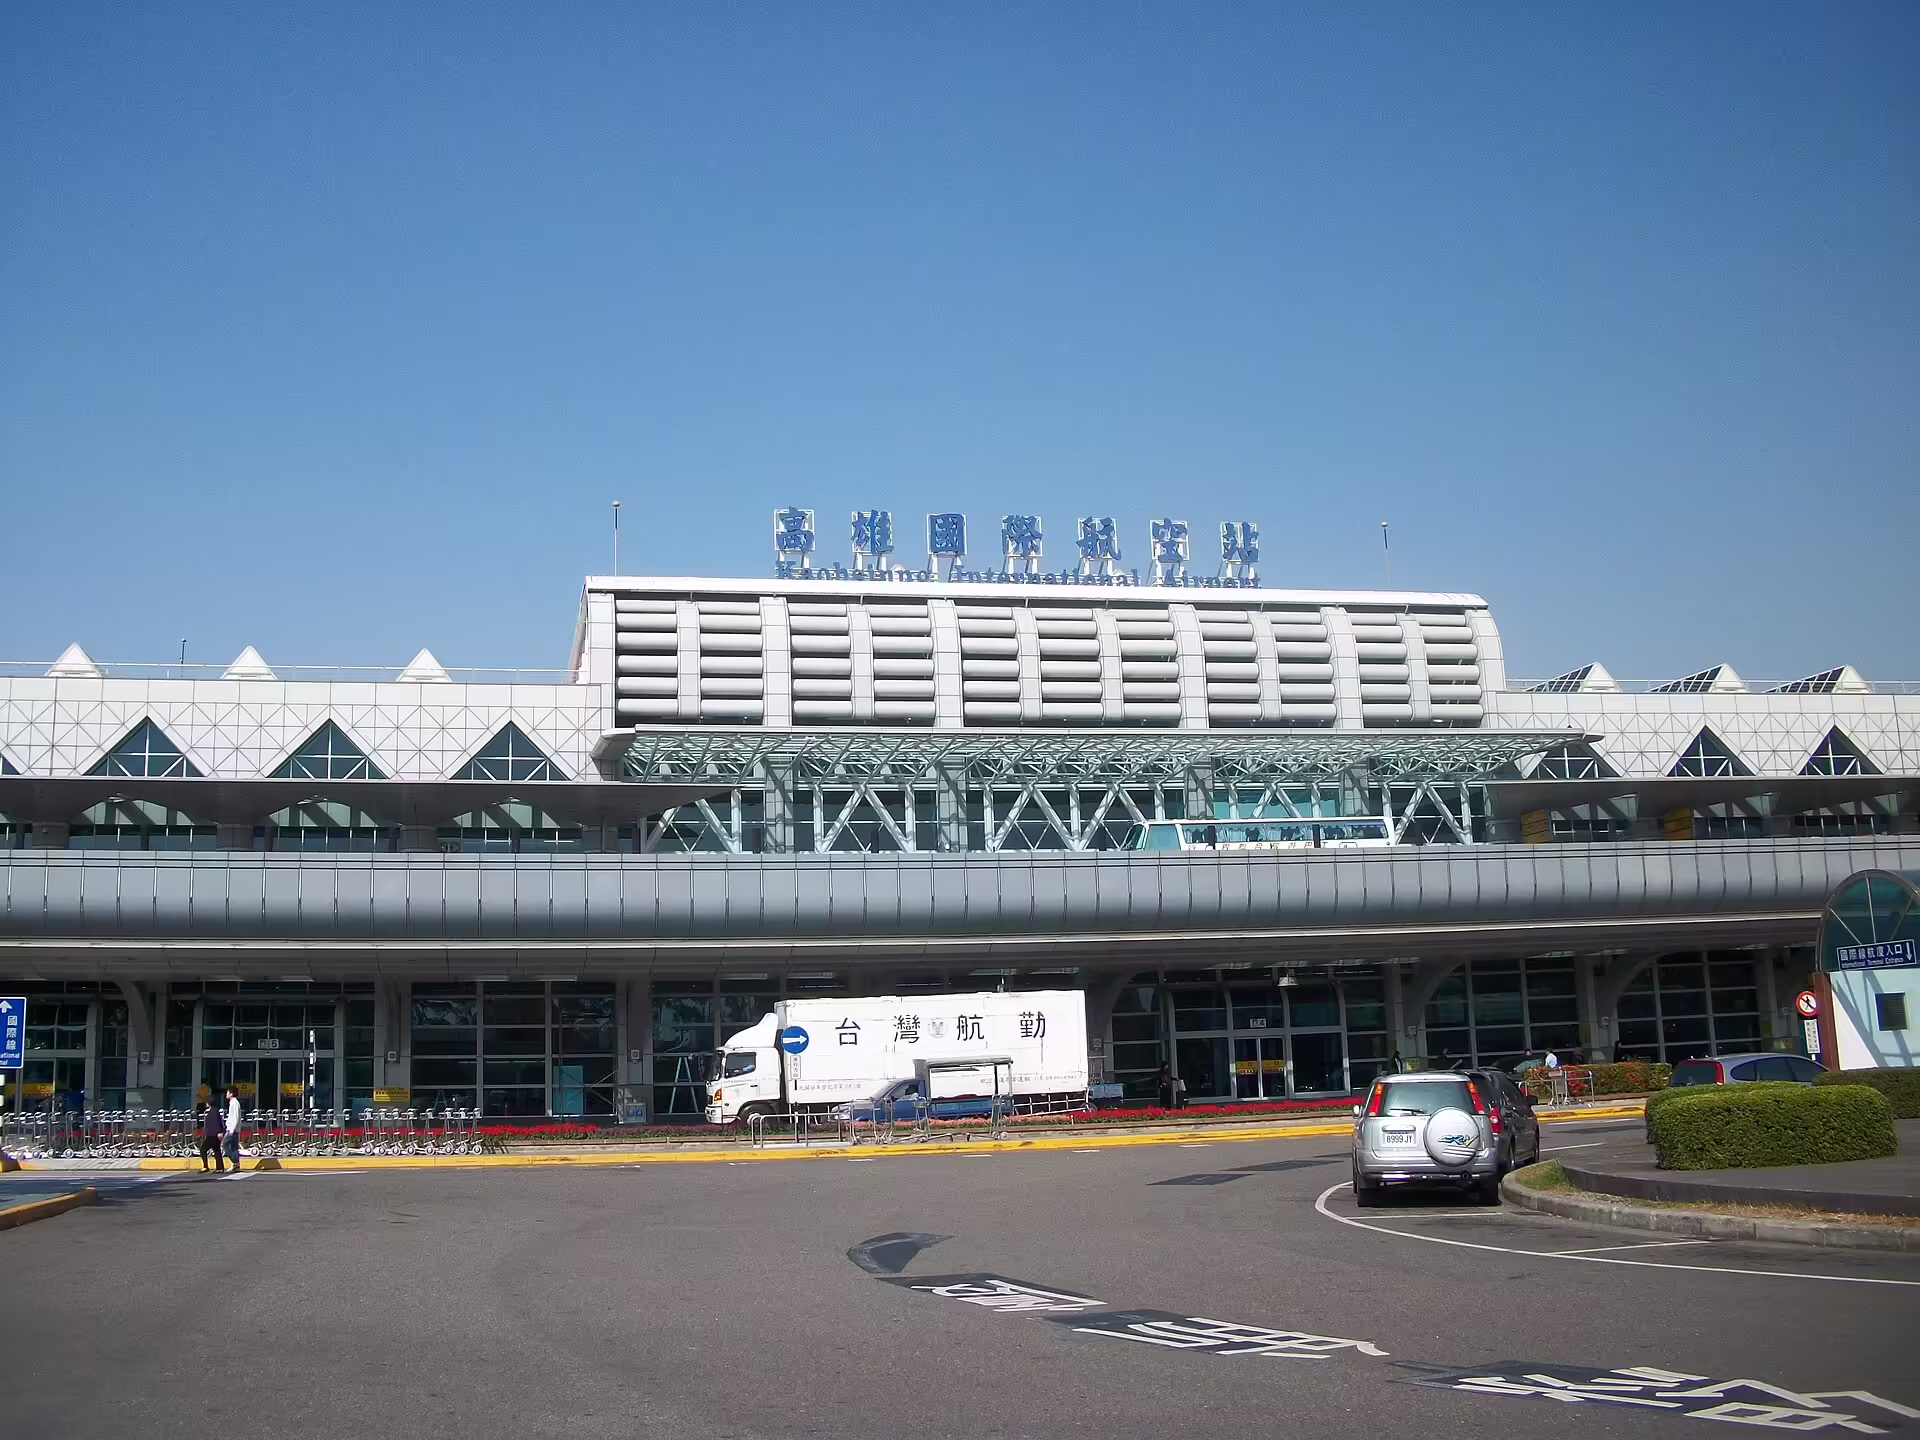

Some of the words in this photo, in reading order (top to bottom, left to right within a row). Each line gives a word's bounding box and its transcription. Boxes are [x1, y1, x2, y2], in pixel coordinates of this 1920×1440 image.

[775, 506, 1260, 563] 高雄國際航空站
[953, 564, 1139, 587] International
[6, 1015, 18, 1050] 國際線
[835, 1011, 1046, 1046] 台灣航勤
